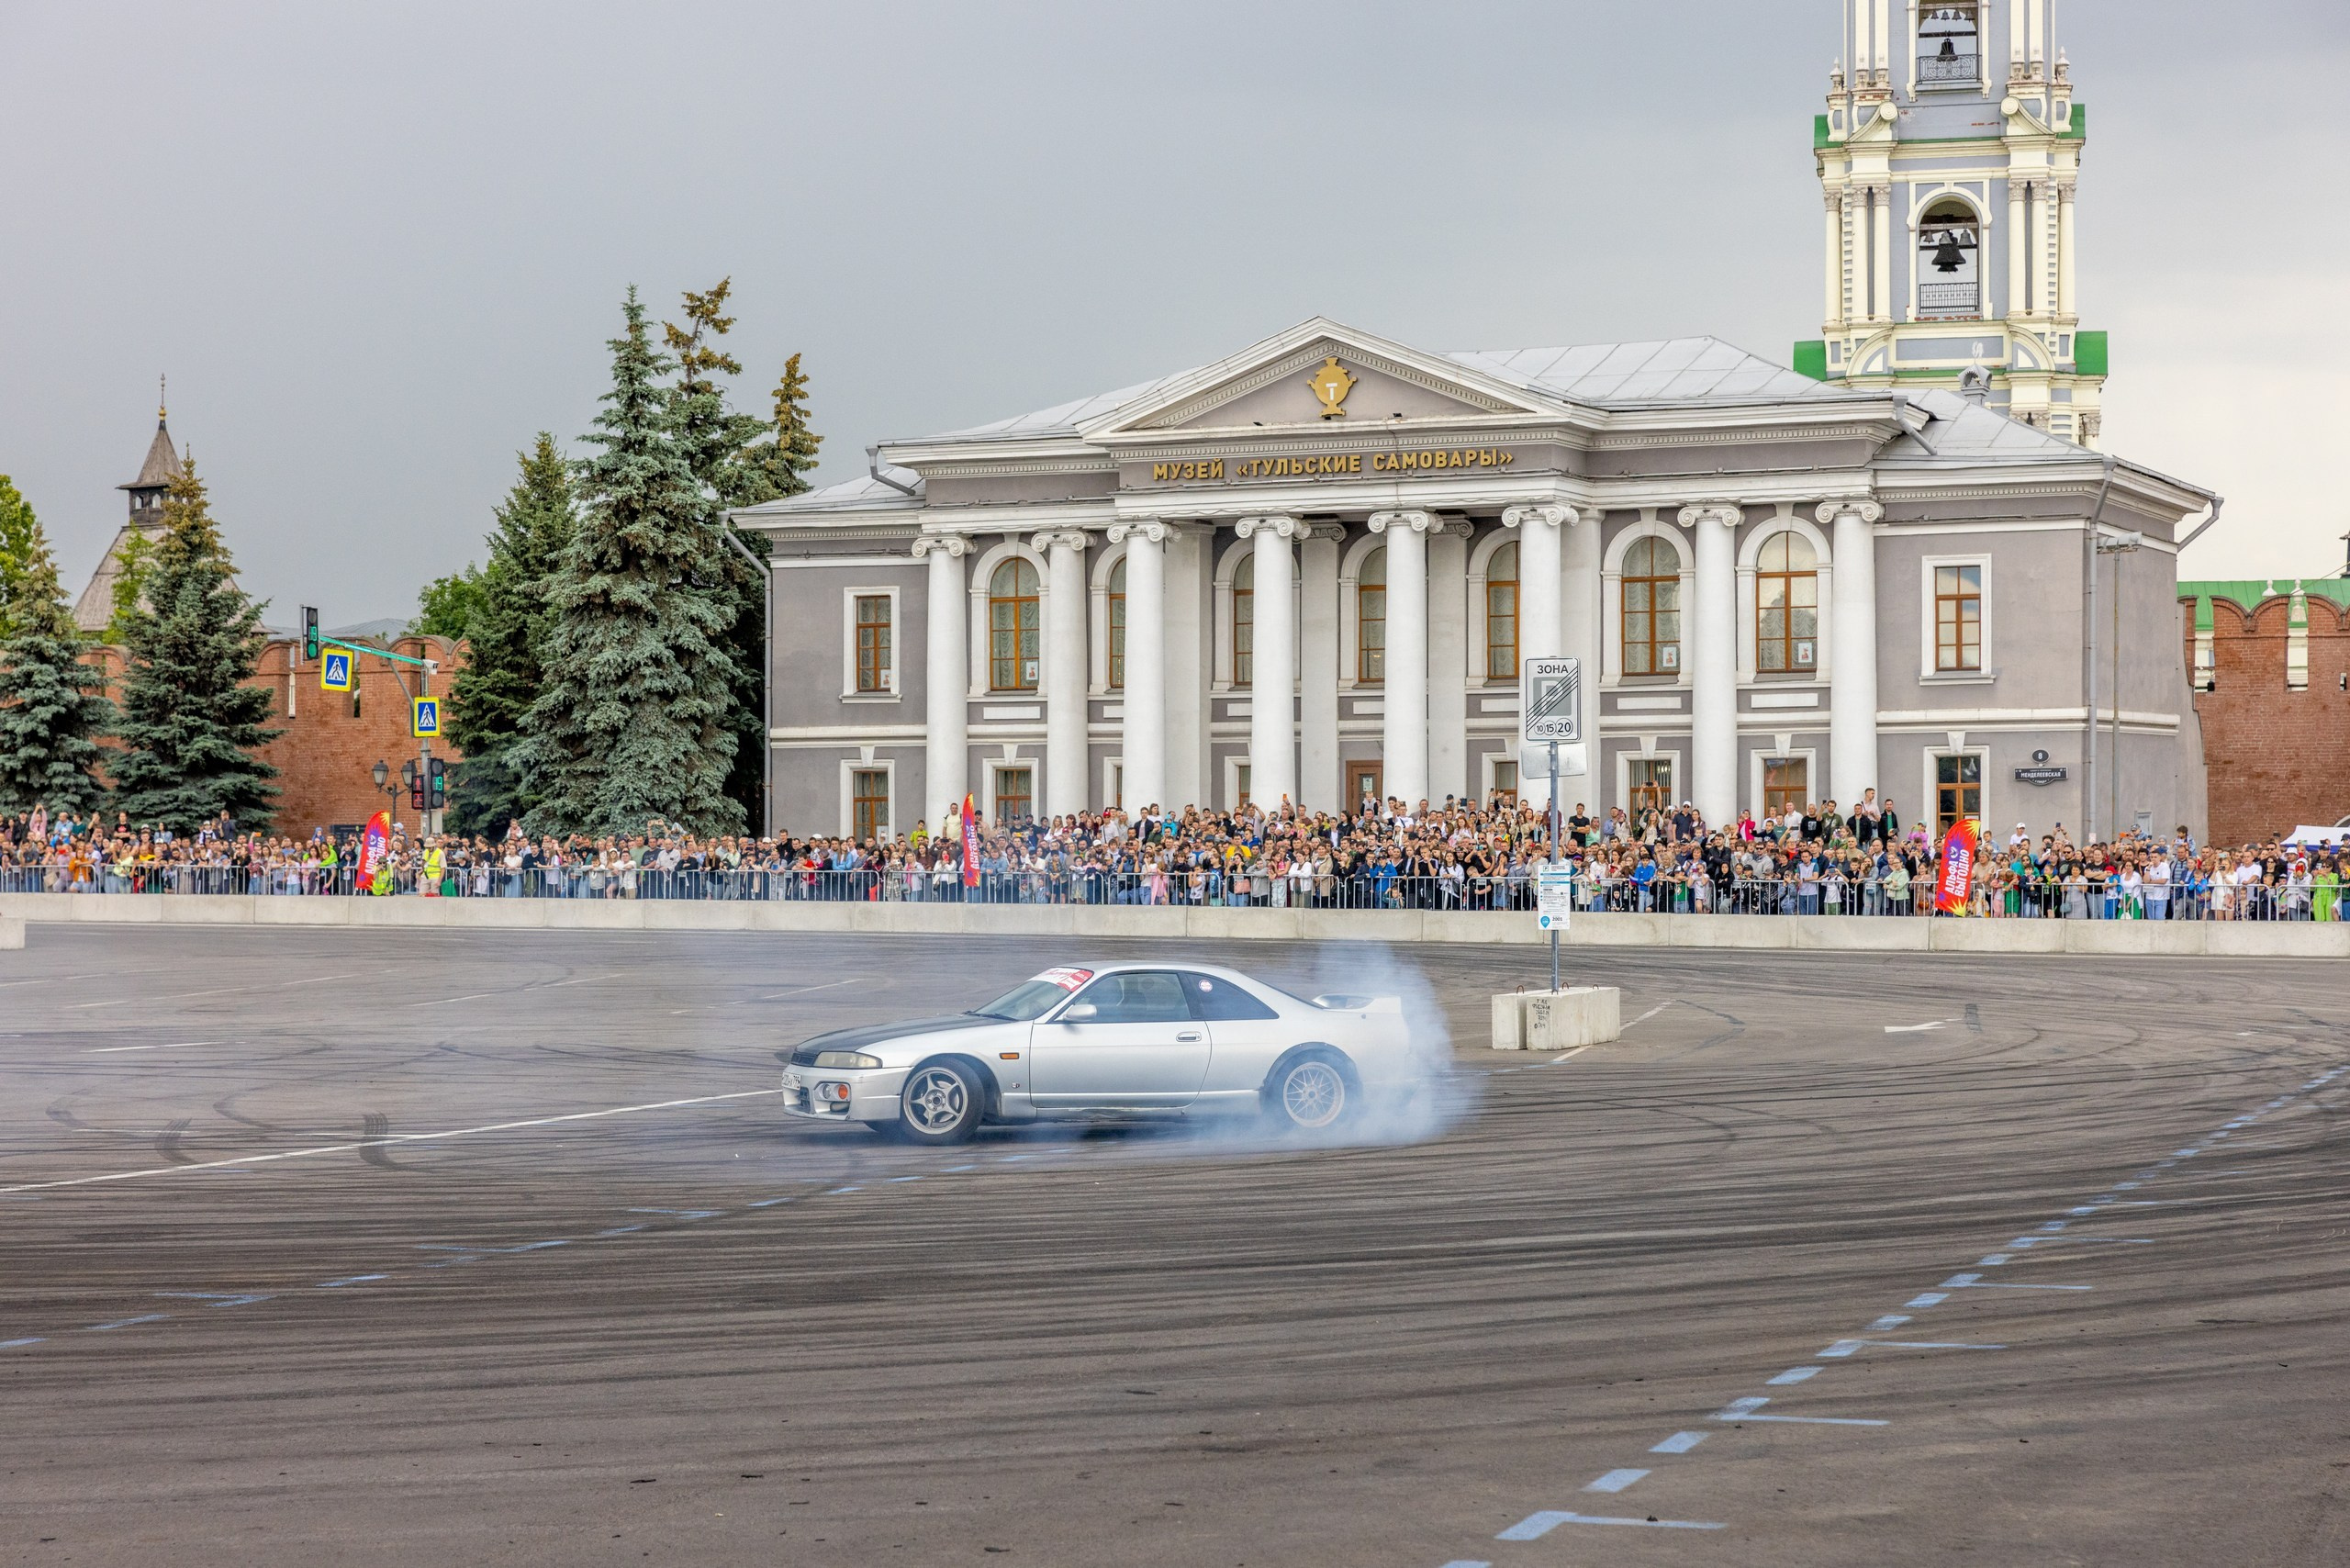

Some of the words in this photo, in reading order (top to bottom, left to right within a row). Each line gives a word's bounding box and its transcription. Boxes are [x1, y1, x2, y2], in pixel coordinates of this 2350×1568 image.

[1153, 457, 1225, 480] МУЗЕЙ
[1236, 454, 1362, 476] «ТУЛЬСКИЕ
[1372, 448, 1514, 470] САМОВАРЫ»
[1537, 665, 1569, 674] ЗОНА
[1536, 724, 1543, 733] 10
[1545, 723, 1554, 733] 15
[1557, 722, 1572, 733] 20
[364, 846, 376, 874] АЛЬФА
[1954, 849, 1969, 897] ВЫГОДНО
[1944, 860, 1958, 894] АЛЬФА
